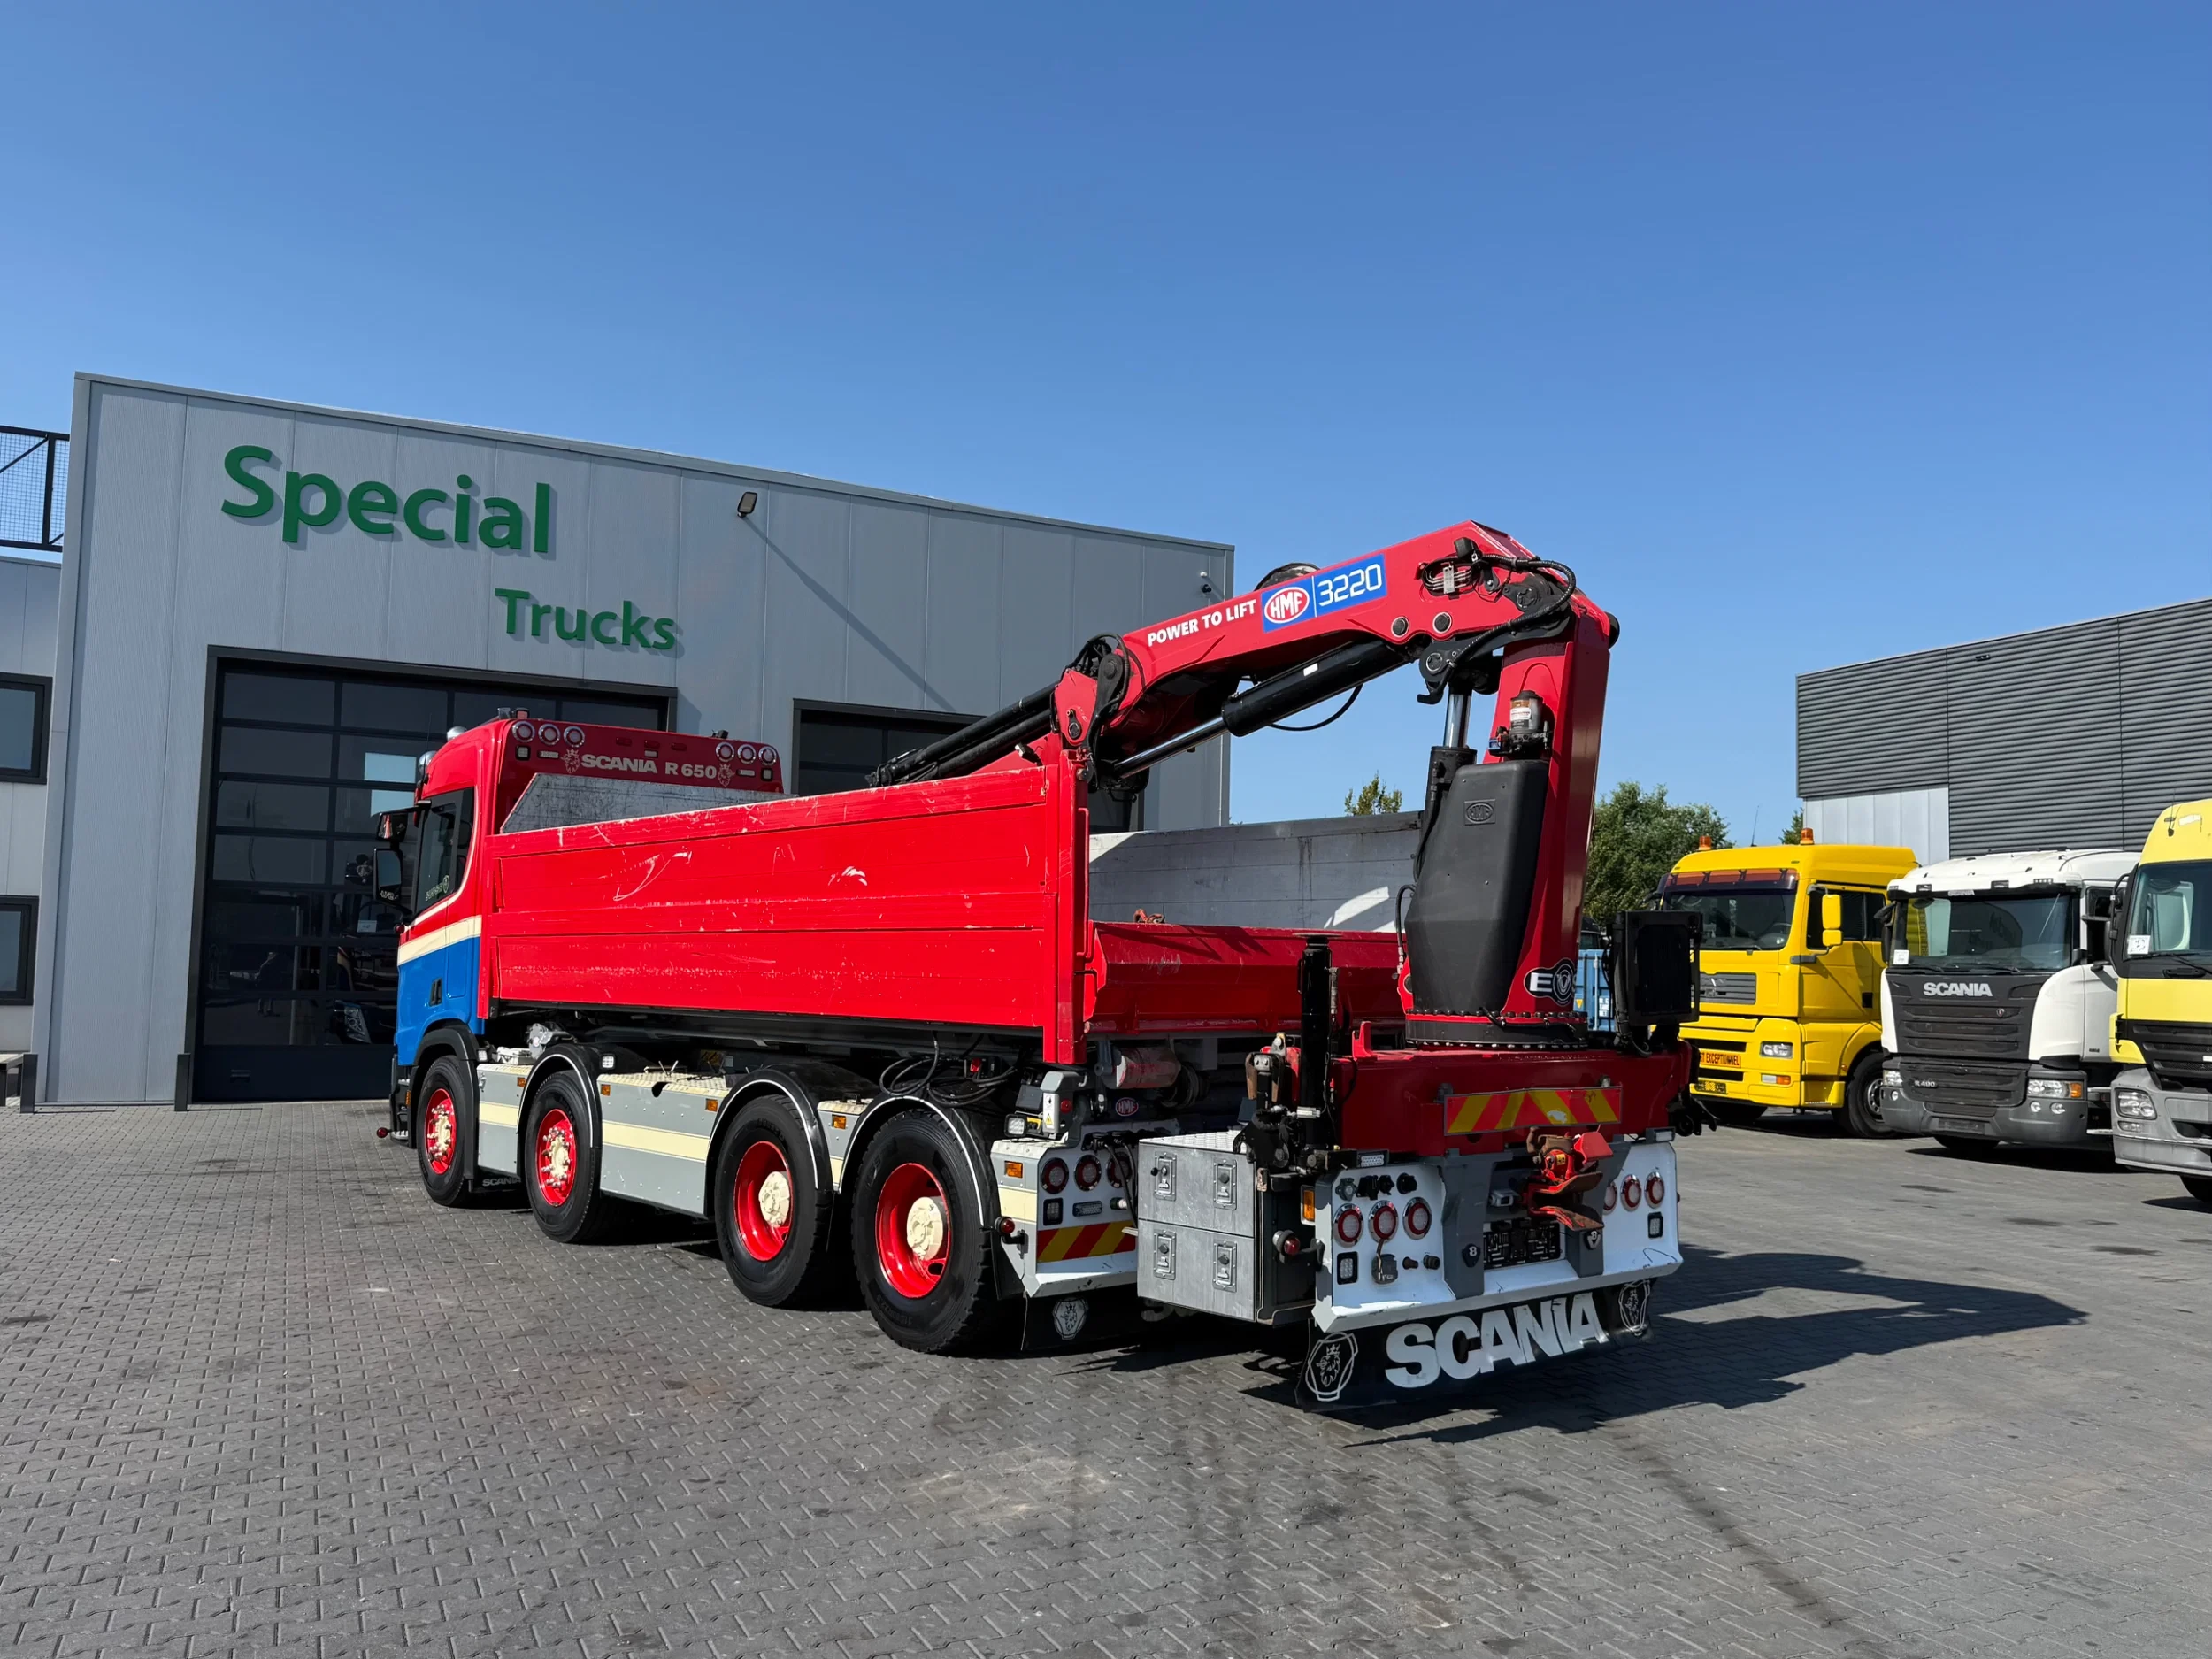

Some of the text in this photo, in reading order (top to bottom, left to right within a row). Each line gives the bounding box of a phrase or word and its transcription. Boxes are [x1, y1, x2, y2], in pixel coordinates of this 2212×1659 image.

[221, 445, 550, 553] Special
[1317, 563, 1383, 607] 3220
[495, 588, 676, 650] Trucks
[1269, 590, 1304, 619] HMF
[1148, 599, 1256, 647] POWER TO LIFT
[580, 754, 718, 780] SCANIA R 650
[1923, 981, 1993, 997] SCANIA
[1118, 1099, 1136, 1114] HMF
[482, 1177, 522, 1187] SCANIA
[1385, 1292, 1609, 1389] SCANIA
